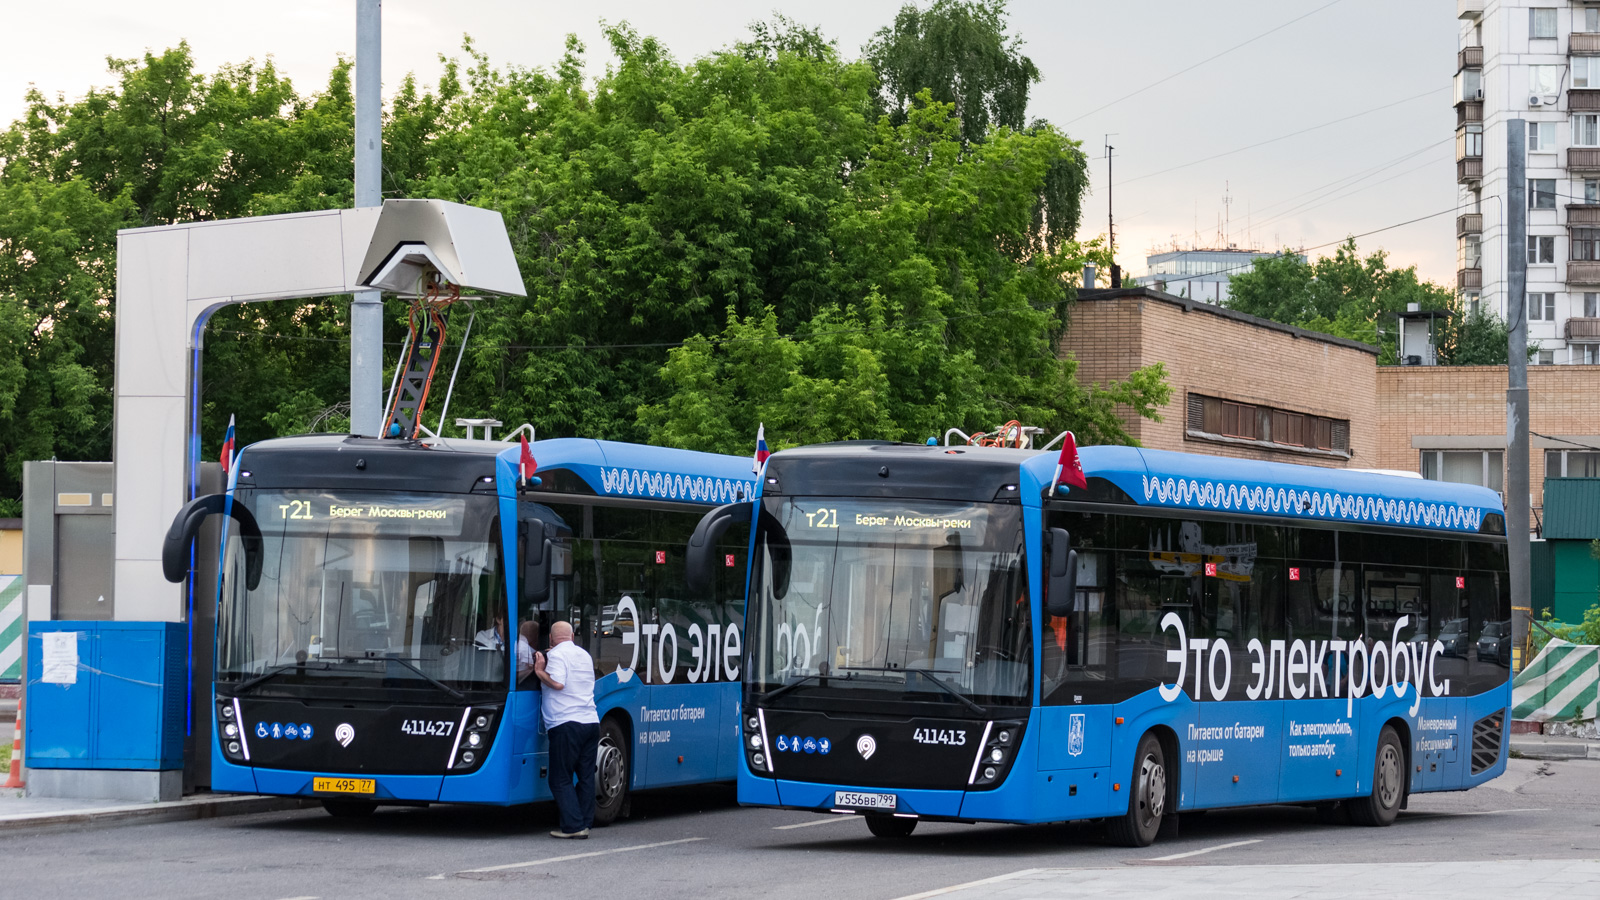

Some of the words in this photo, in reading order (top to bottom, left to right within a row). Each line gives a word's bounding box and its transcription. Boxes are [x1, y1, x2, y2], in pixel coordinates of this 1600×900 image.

[330, 505, 363, 518] Берег
[368, 506, 446, 519] Москвы-реки
[856, 514, 888, 526] Берег
[894, 515, 971, 528] Москвы-реки
[616, 596, 678, 684] Это
[1158, 612, 1232, 702] Это
[1246, 614, 1450, 718] электробус.
[640, 706, 670, 722] Питается
[671, 708, 678, 720] от
[680, 704, 705, 723] батареи
[402, 720, 454, 736] 411427
[1188, 724, 1222, 740] Питается
[1224, 726, 1233, 740] от
[1234, 722, 1264, 742] батареи
[1290, 720, 1302, 736] Как
[1302, 718, 1352, 738] электромобиль,
[1417, 716, 1457, 734] Маневренный
[639, 731, 648, 744] на
[648, 730, 670, 747] крыше
[913, 728, 966, 745] 411413
[1416, 741, 1420, 752] и
[1420, 735, 1452, 754] бесшумный
[1186, 750, 1196, 762] на
[1197, 748, 1224, 766] крыше
[1288, 744, 1310, 757] только
[1310, 739, 1336, 759] автобус
[336, 780, 355, 790] 495
[362, 780, 372, 788] 77
